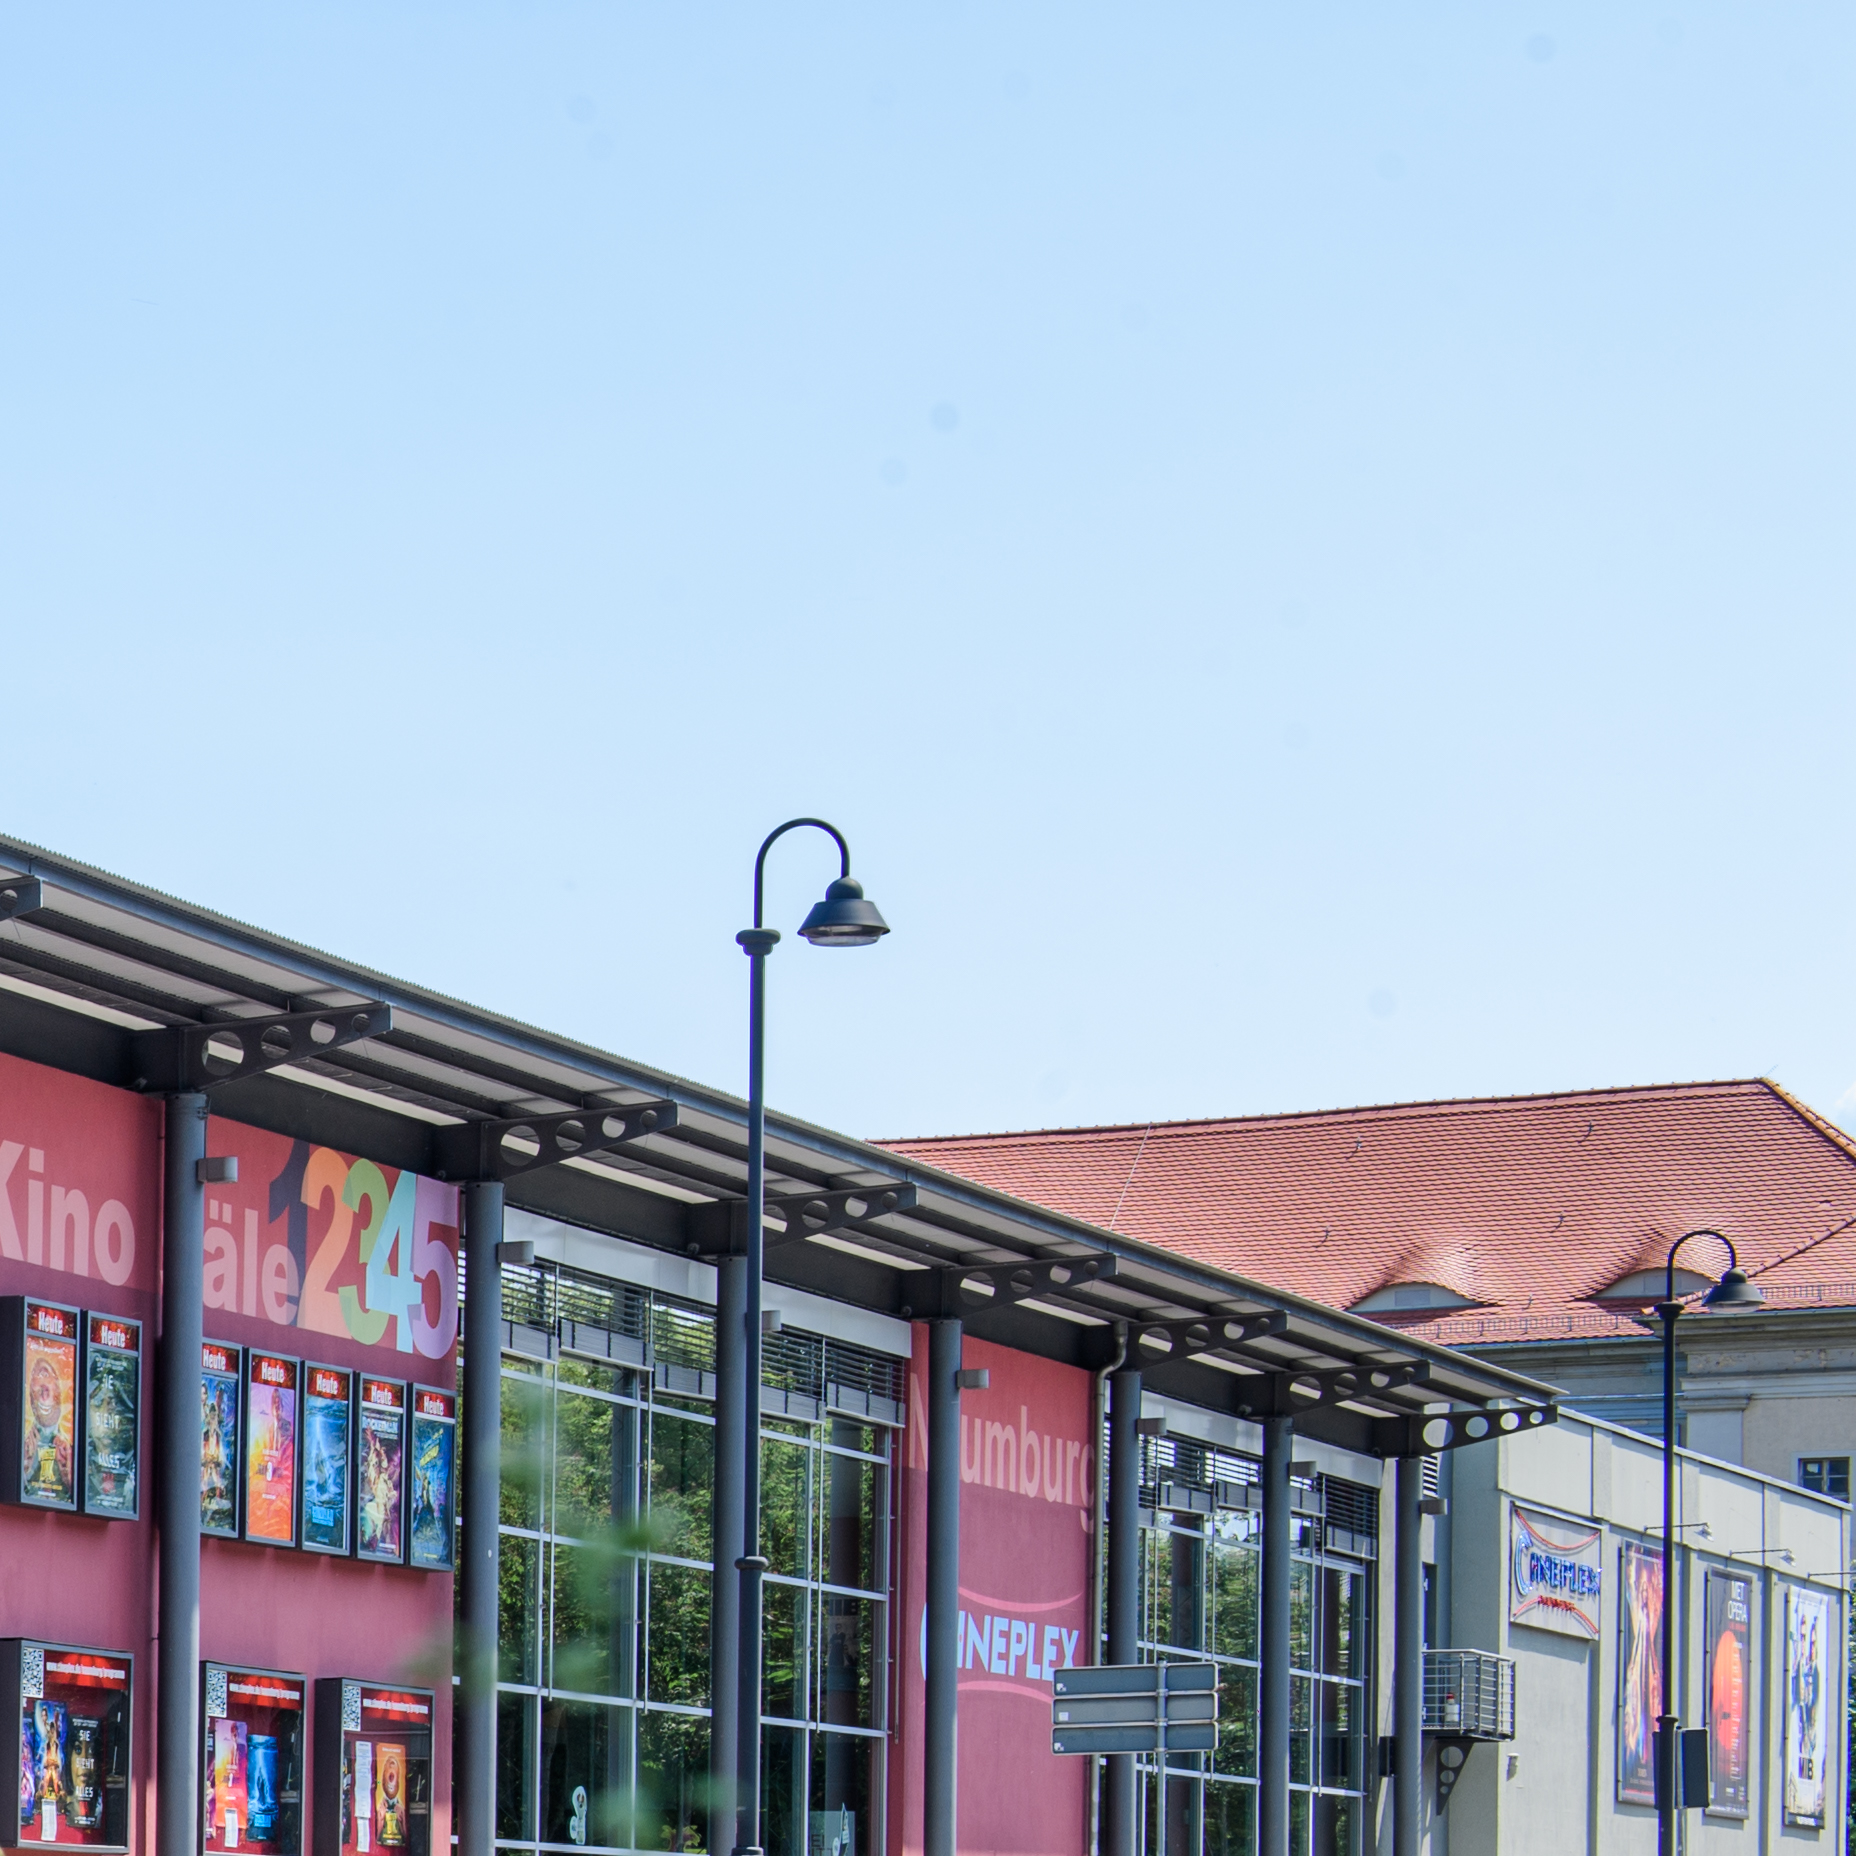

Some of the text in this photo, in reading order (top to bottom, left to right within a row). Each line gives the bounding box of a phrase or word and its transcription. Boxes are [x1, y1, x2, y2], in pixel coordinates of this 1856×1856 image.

[202, 1199, 300, 1326] äle
[38, 1310, 63, 1335] Heute
[101, 1324, 126, 1348] Heute
[203, 1348, 226, 1371] Heute
[261, 1361, 285, 1383] Heute
[316, 1374, 338, 1395] Heute
[371, 1385, 392, 1405] Heute
[423, 1396, 444, 1416] Heute
[909, 1372, 1094, 1534] Numburg
[1514, 1529, 1600, 1596] CINEPLEX
[1731, 1580, 1745, 1600] MET
[1728, 1600, 1748, 1622] OPERA
[920, 1602, 1080, 1681] INEPLEX
